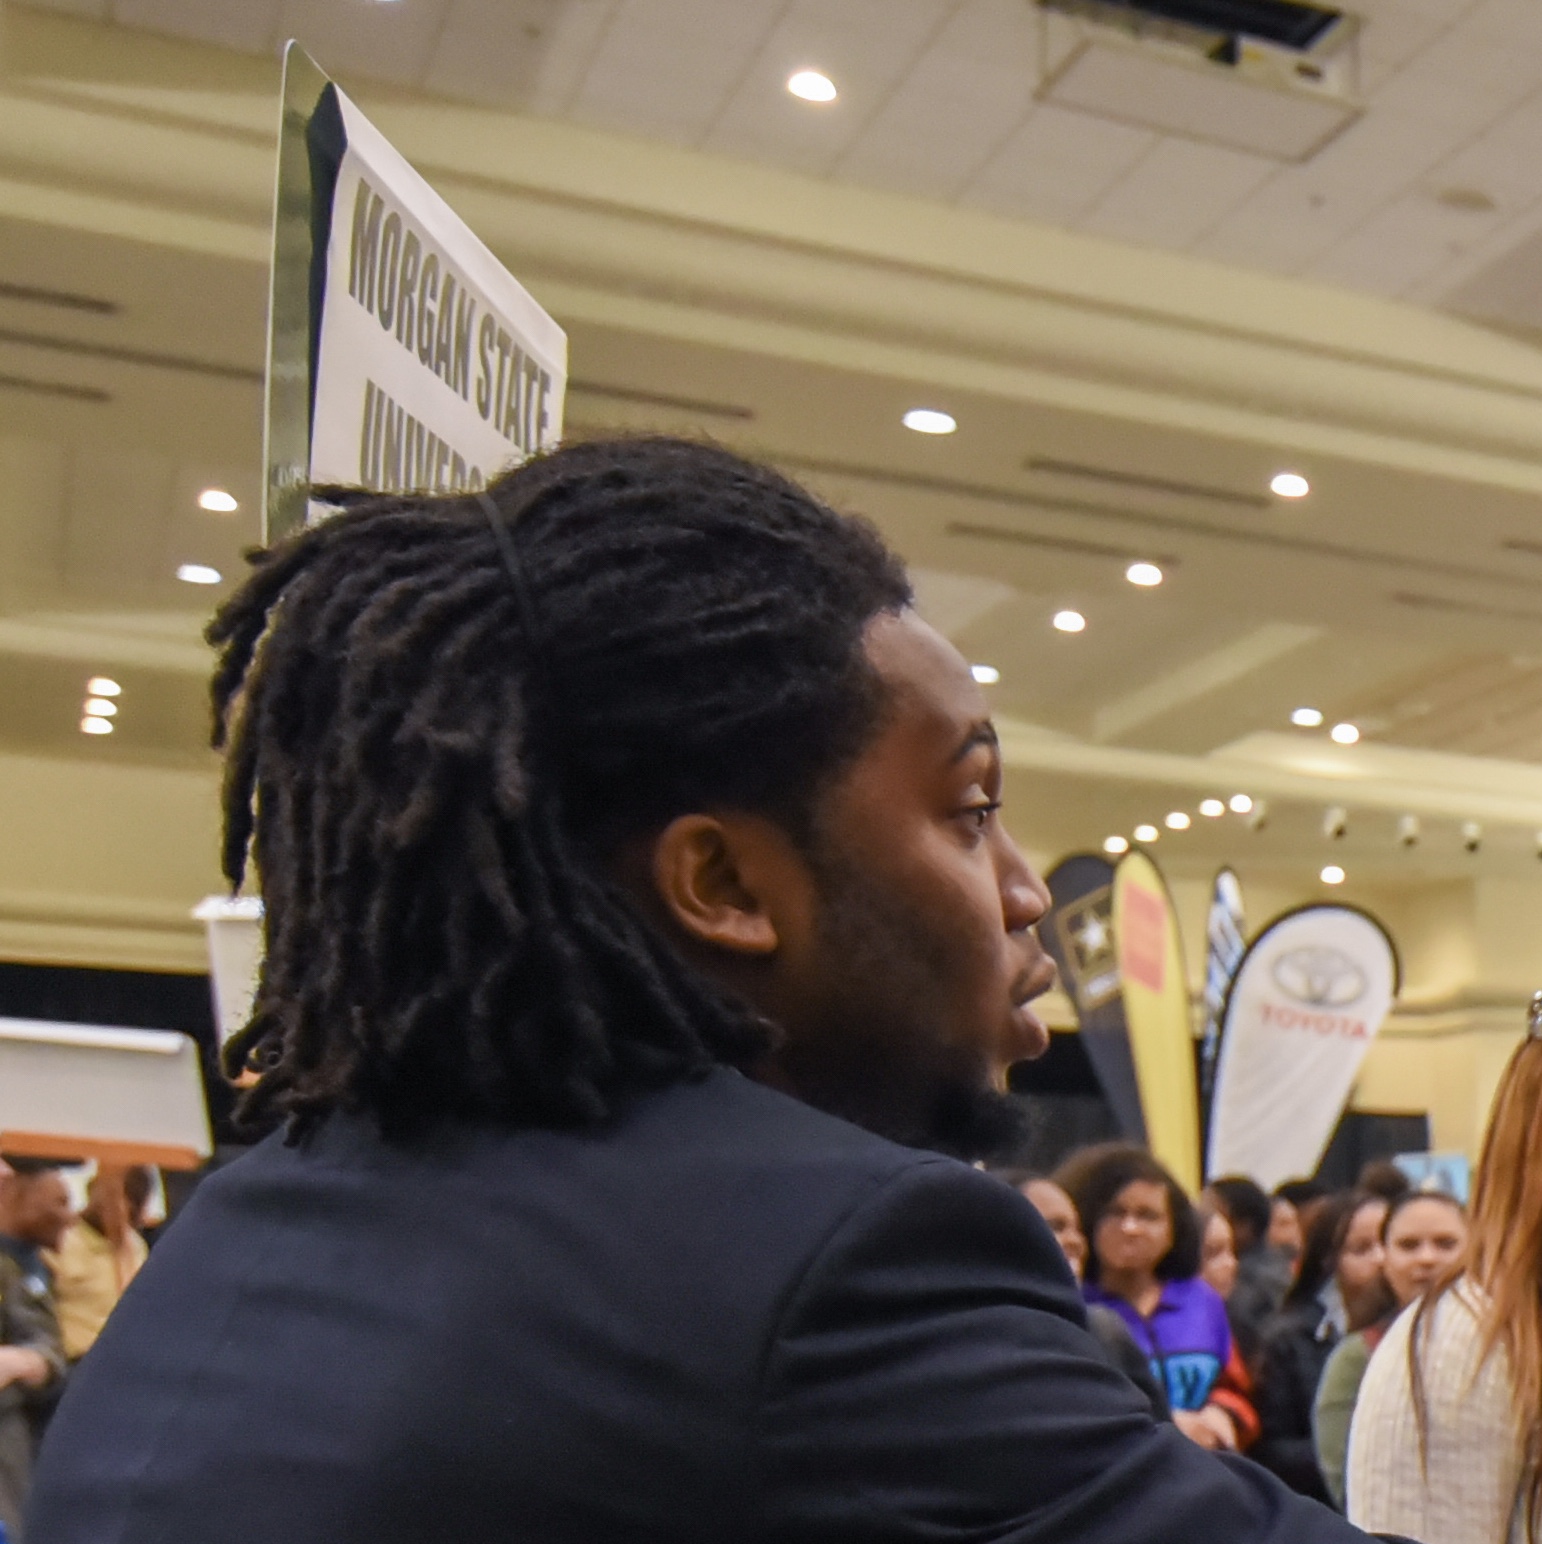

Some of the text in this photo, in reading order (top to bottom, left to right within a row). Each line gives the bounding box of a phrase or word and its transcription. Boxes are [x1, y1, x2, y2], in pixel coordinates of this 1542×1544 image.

[348, 177, 551, 455] MORGAN STATE
[360, 377, 483, 493] UNIVE
[1261, 1004, 1369, 1039] TOYOTA
